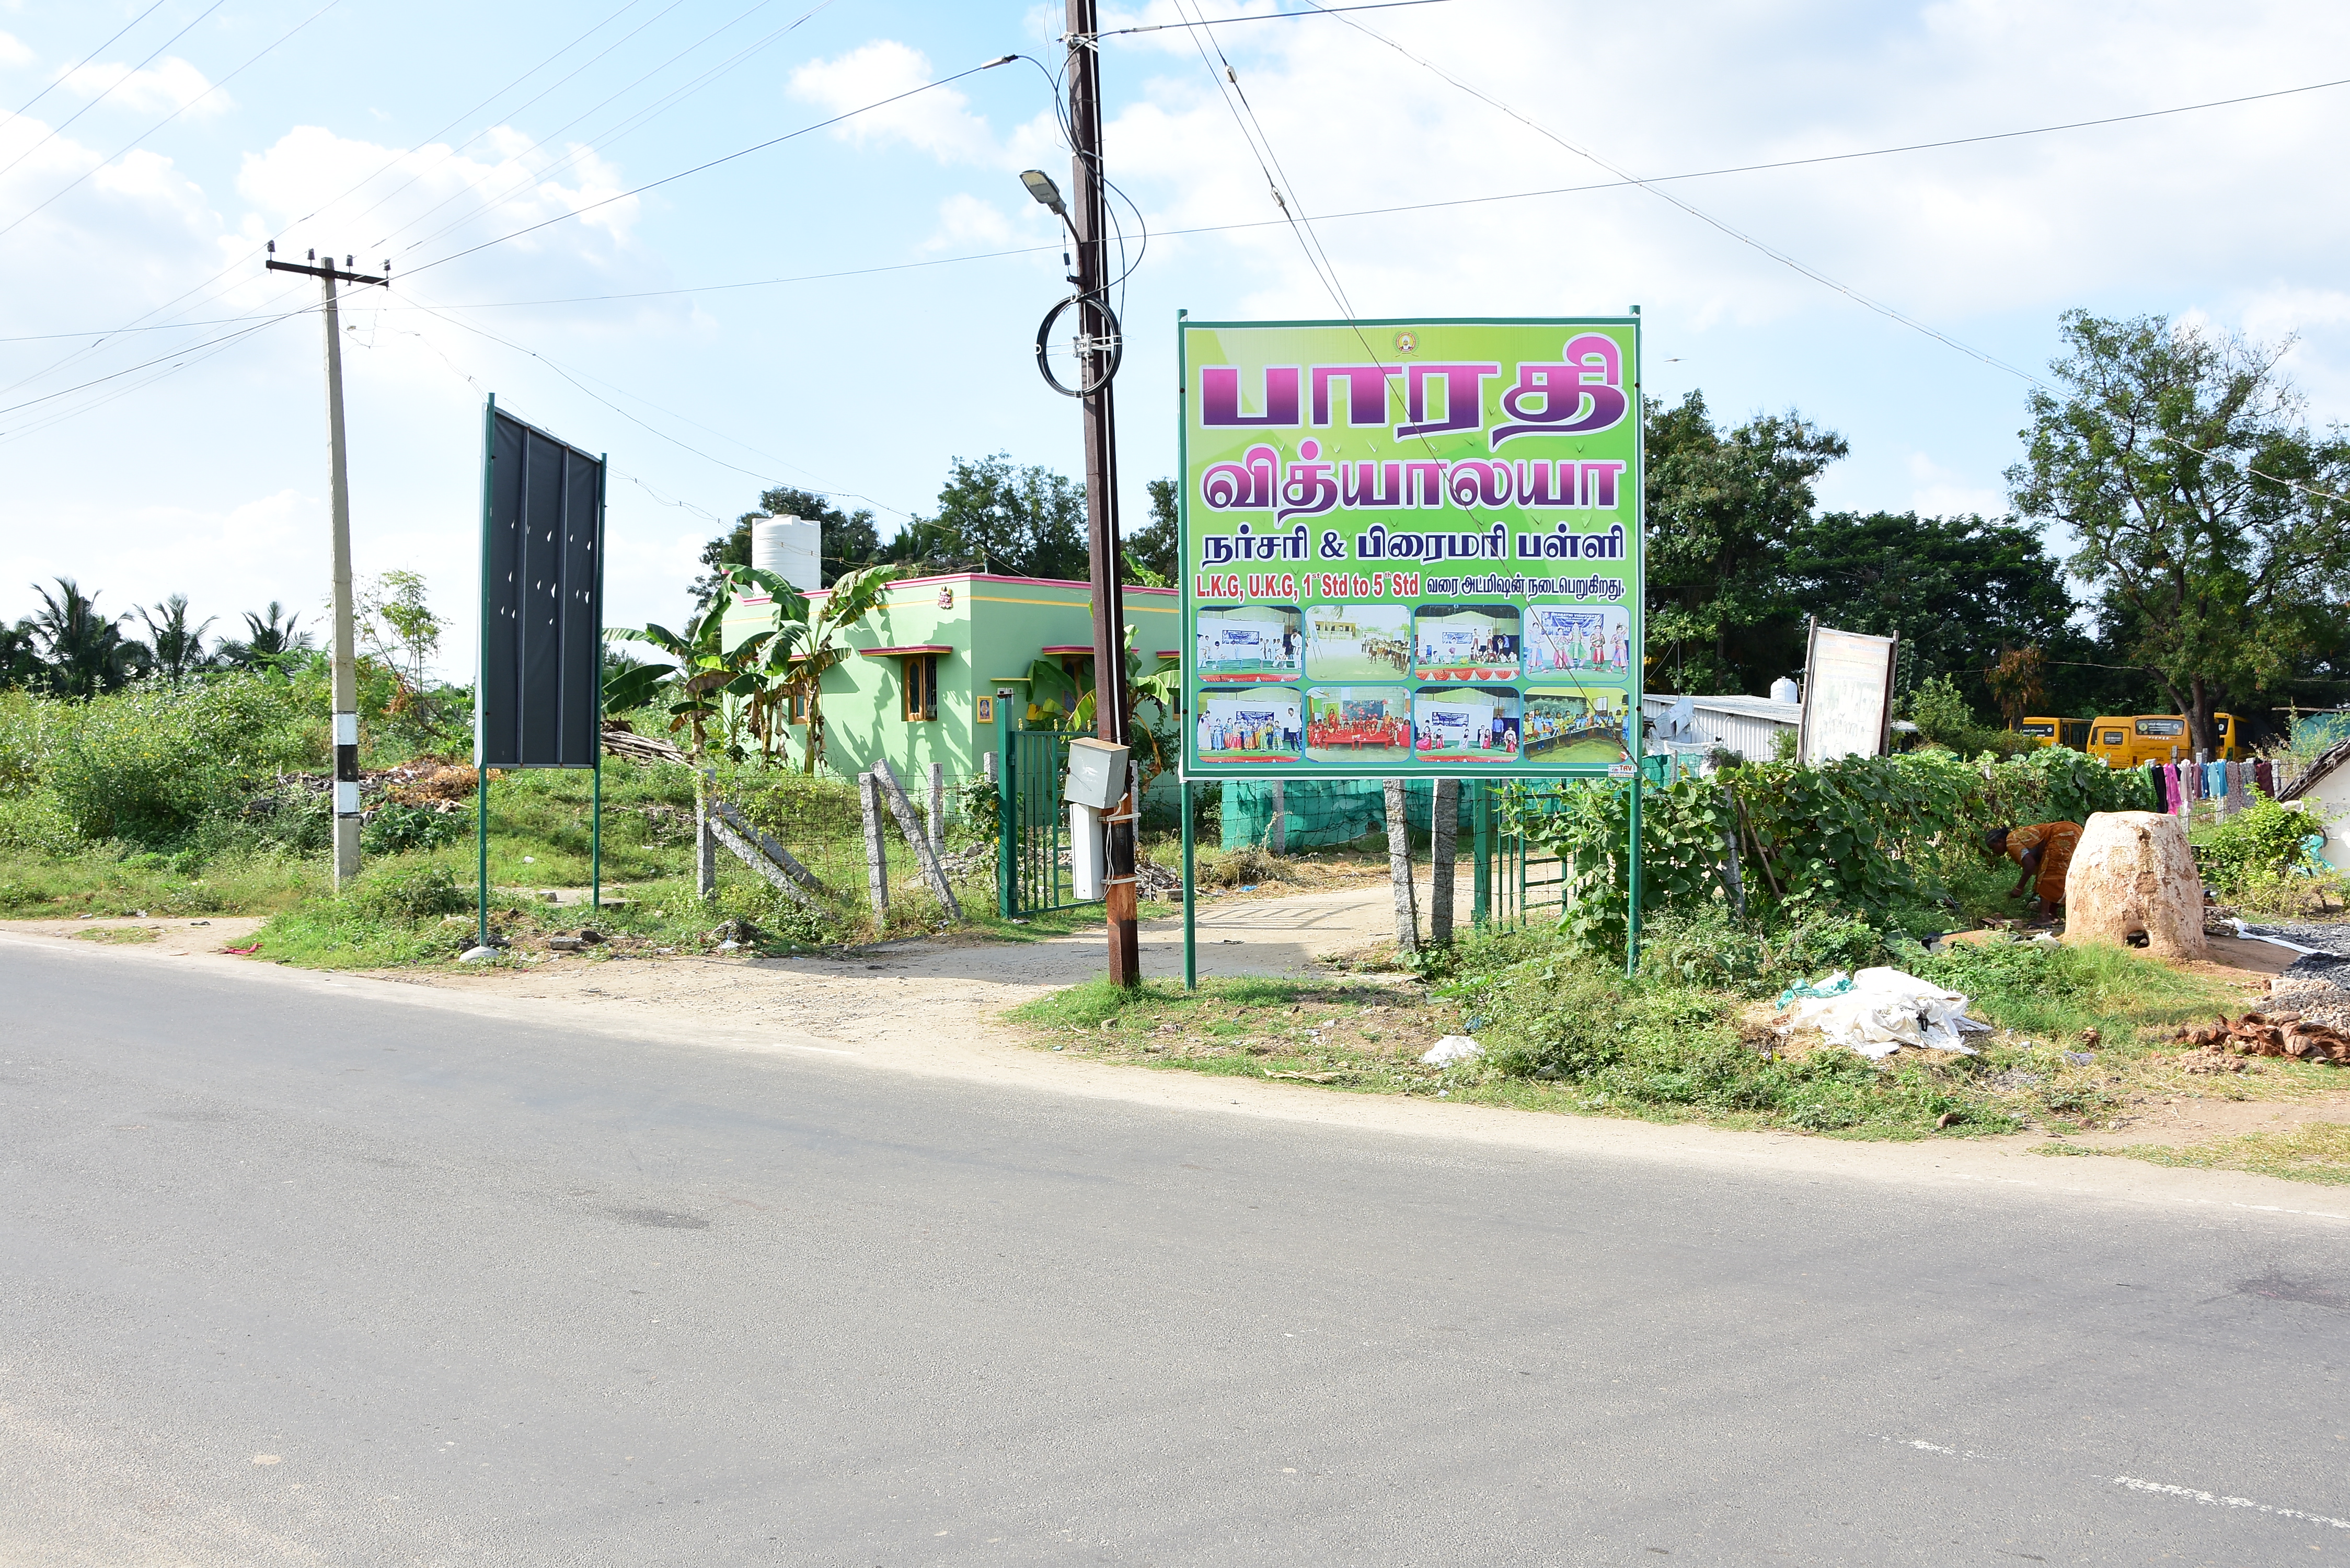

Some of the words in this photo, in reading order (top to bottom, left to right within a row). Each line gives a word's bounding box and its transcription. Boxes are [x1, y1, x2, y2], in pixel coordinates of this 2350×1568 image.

[1202, 336, 1626, 446] பாரதி
[1203, 440, 1623, 524] வித்யாலயா
[1202, 524, 1307, 569] நர்சரி
[1320, 532, 1345, 558] &
[1358, 525, 1506, 562] பிரைமரி
[1518, 523, 1623, 558] பள்ளி
[1196, 575, 1244, 602] L.K.G,
[1249, 575, 1298, 601] U.K.G,
[1322, 574, 1347, 596] Std
[1353, 576, 1368, 596] to
[1392, 573, 1418, 595] Std
[1427, 578, 1458, 596] வரை
[1461, 574, 1525, 597] அட்மிஷன்
